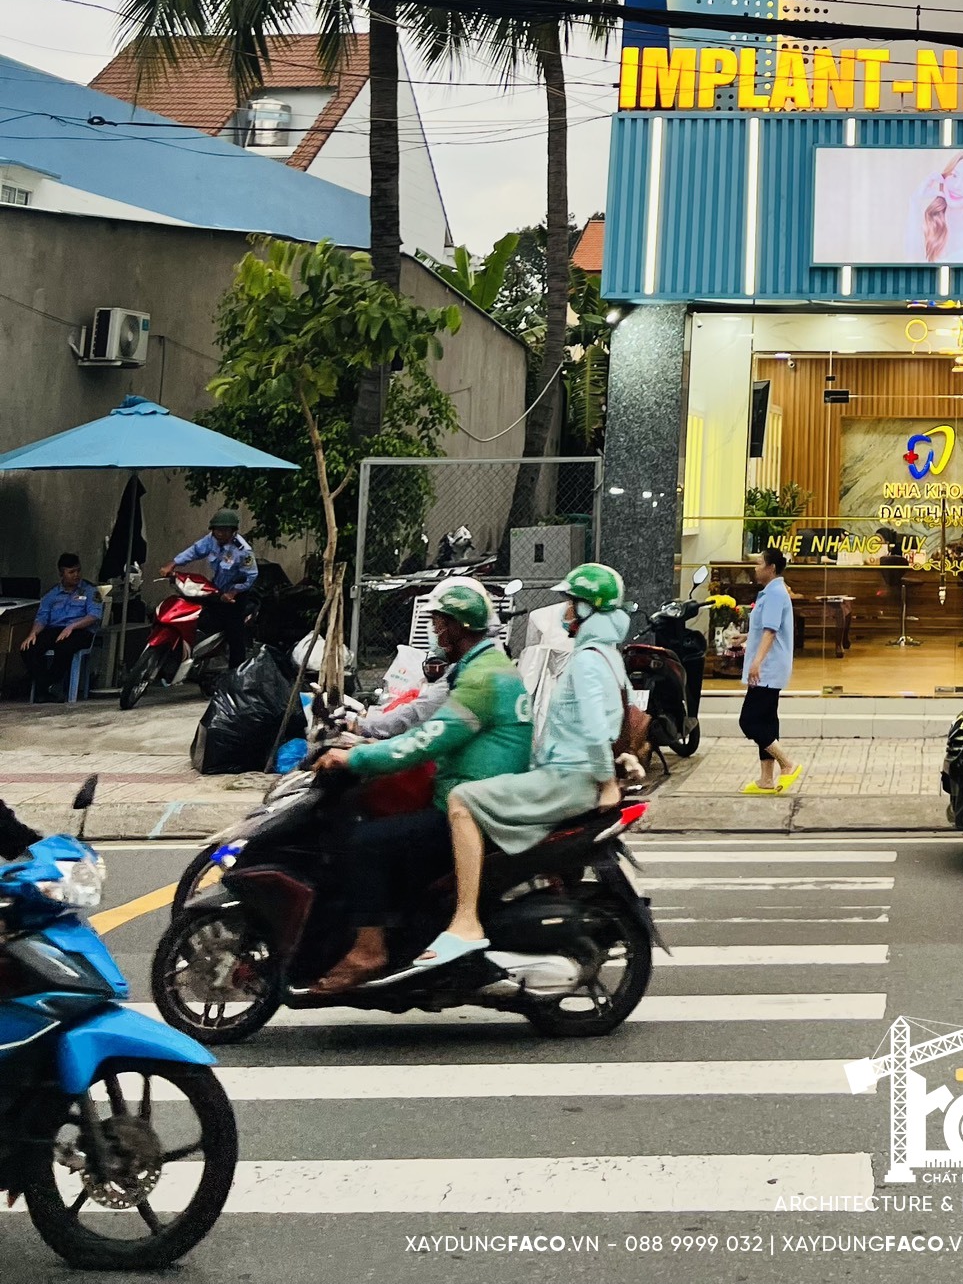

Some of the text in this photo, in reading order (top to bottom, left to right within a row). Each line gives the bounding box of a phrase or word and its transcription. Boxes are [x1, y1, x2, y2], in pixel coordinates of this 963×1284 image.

[883, 482, 921, 499] NHA
[811, 531, 883, 554] NHÀNG
[901, 536, 928, 553] UY
